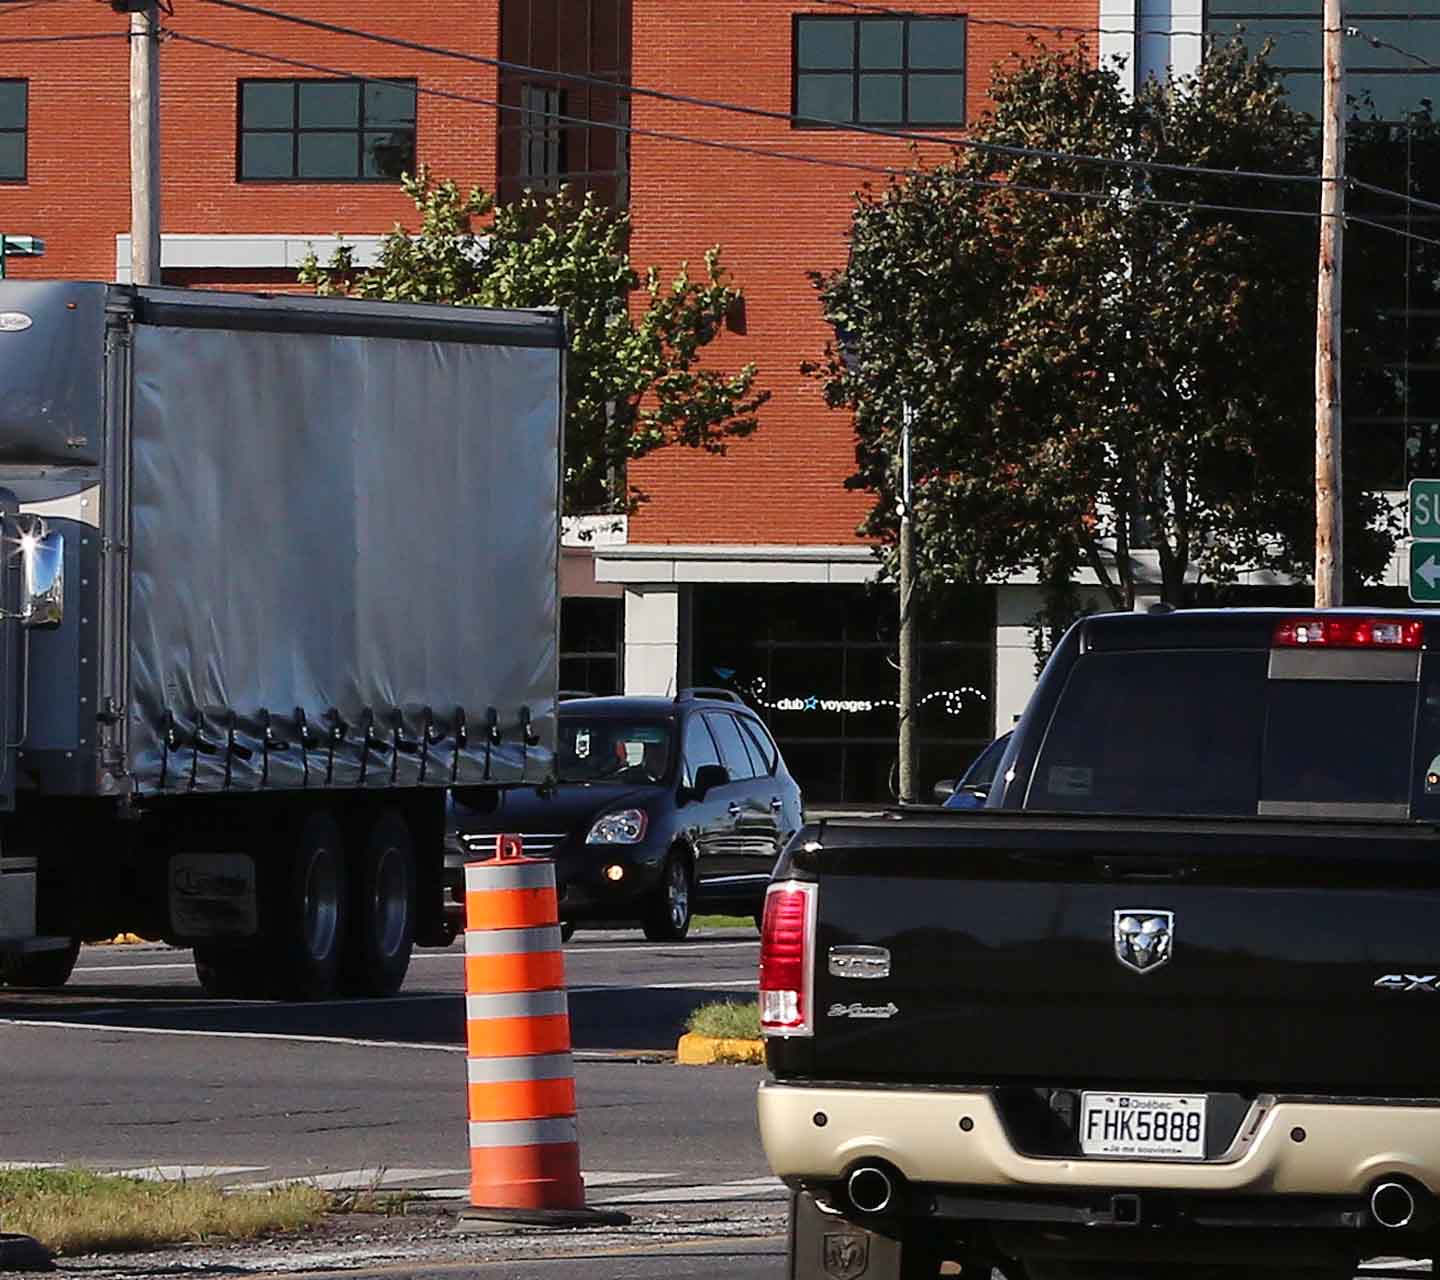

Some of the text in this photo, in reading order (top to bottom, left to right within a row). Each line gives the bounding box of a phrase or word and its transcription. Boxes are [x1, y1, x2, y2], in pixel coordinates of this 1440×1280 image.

[776, 697, 873, 713] club voyages
[1087, 1109, 1201, 1142] FHK5888
